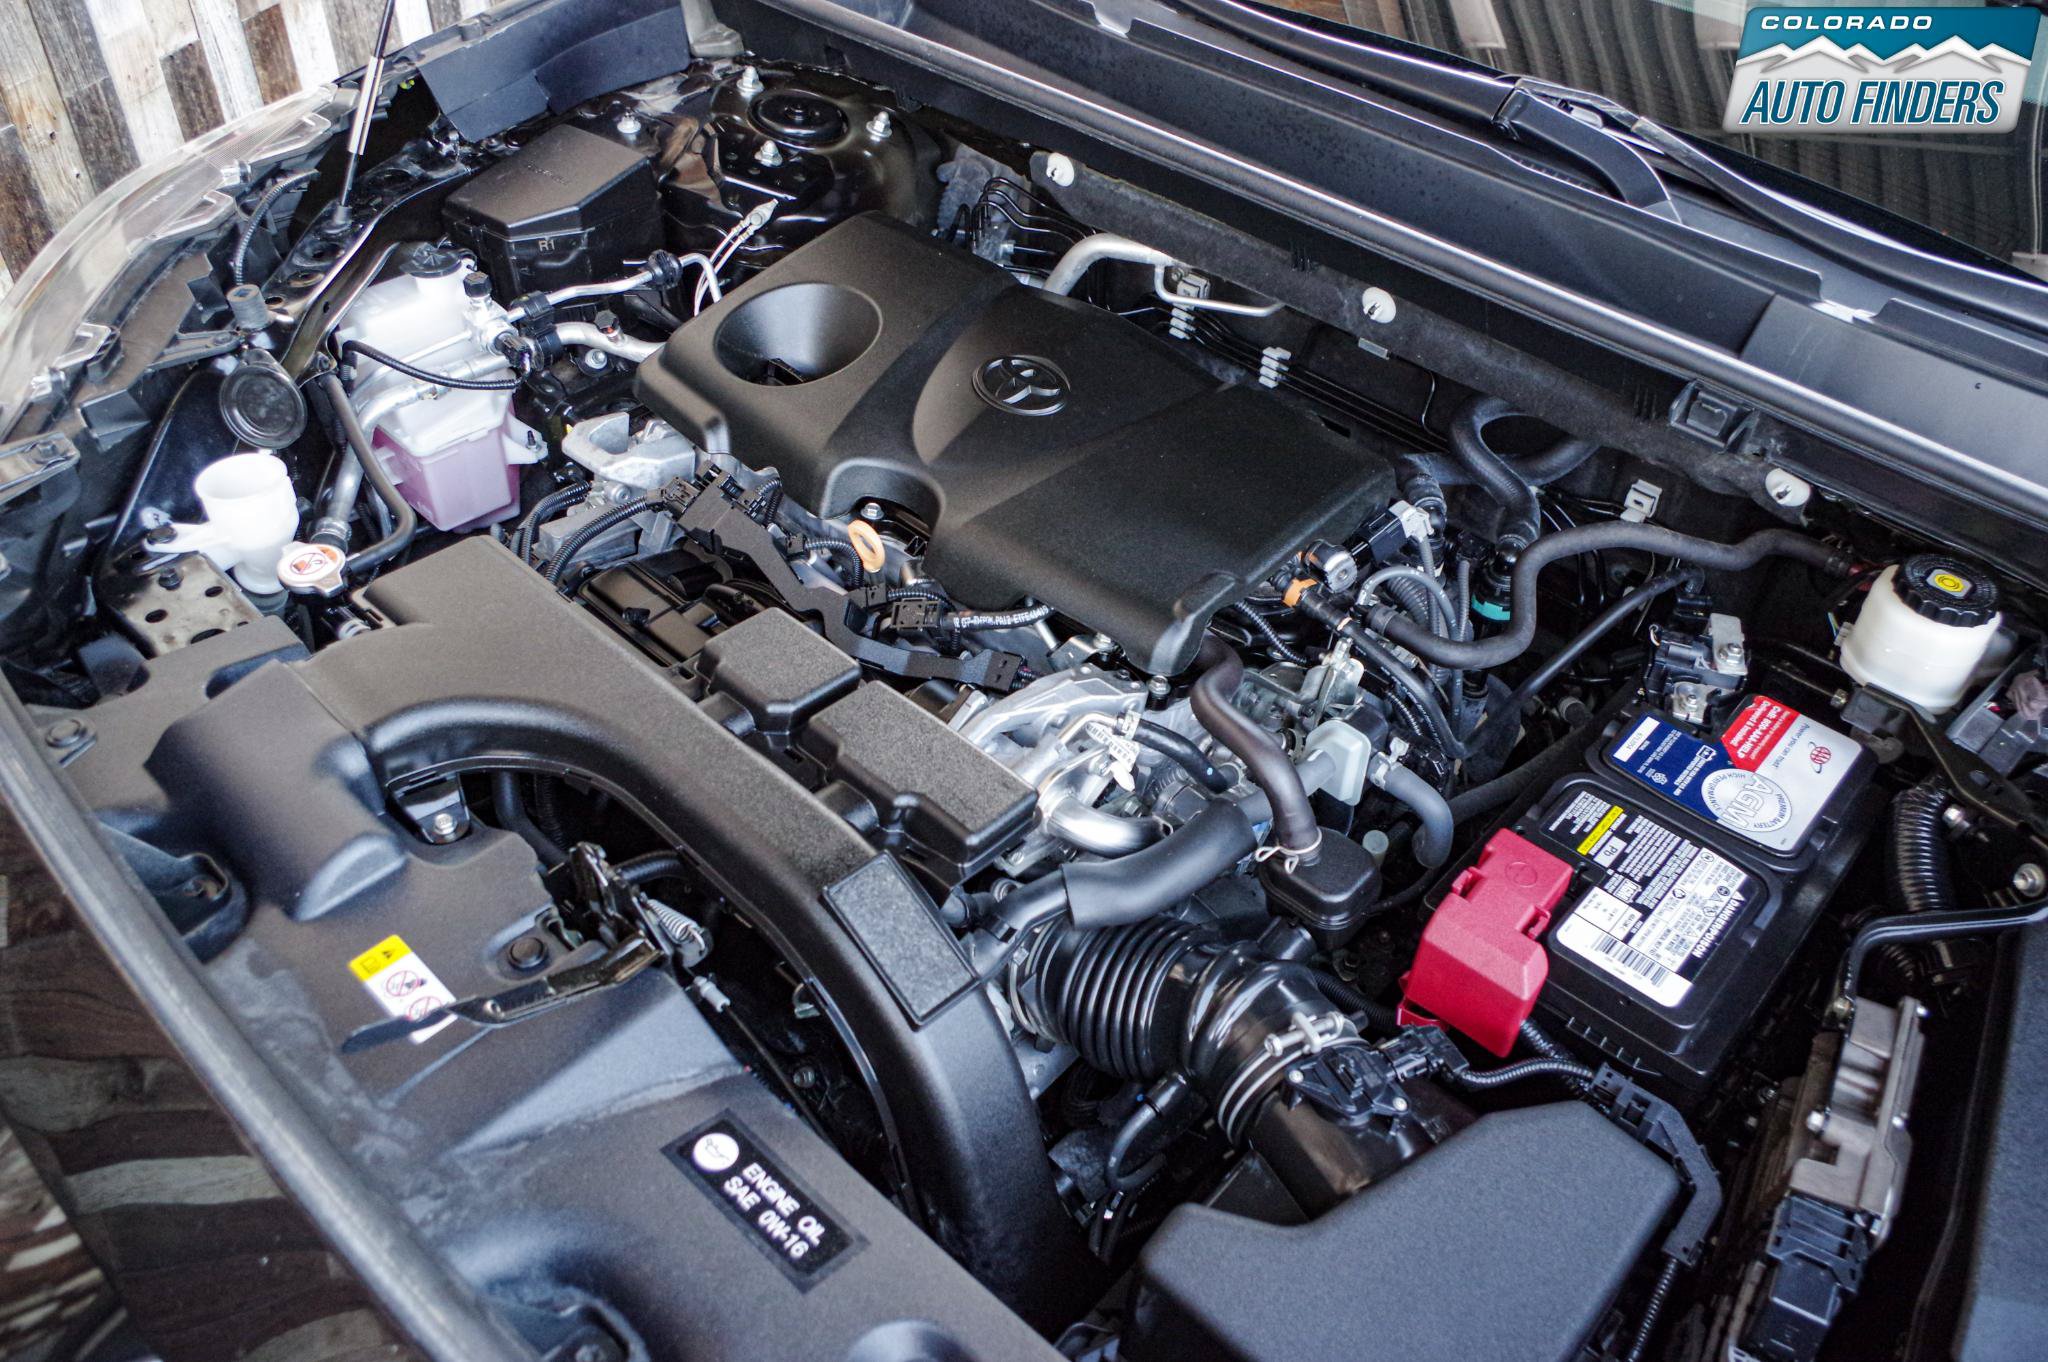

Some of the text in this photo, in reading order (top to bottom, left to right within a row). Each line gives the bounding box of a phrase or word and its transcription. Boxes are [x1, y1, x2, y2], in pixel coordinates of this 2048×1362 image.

[539, 239, 555, 251] R1
[1750, 701, 1771, 723] Delivered
[1781, 747, 1790, 756] can
[1786, 736, 1799, 749] you
[1707, 771, 1746, 811] HIGH PERFORMANCE
[1721, 776, 1773, 830] AGM
[1753, 793, 1786, 828] PREMIUM BATTERY
[1603, 846, 1618, 858] Pb
[1691, 898, 1741, 959] DANGER/POISON
[724, 1176, 761, 1211] SAE
[743, 1162, 825, 1246] ENGINE OIL
